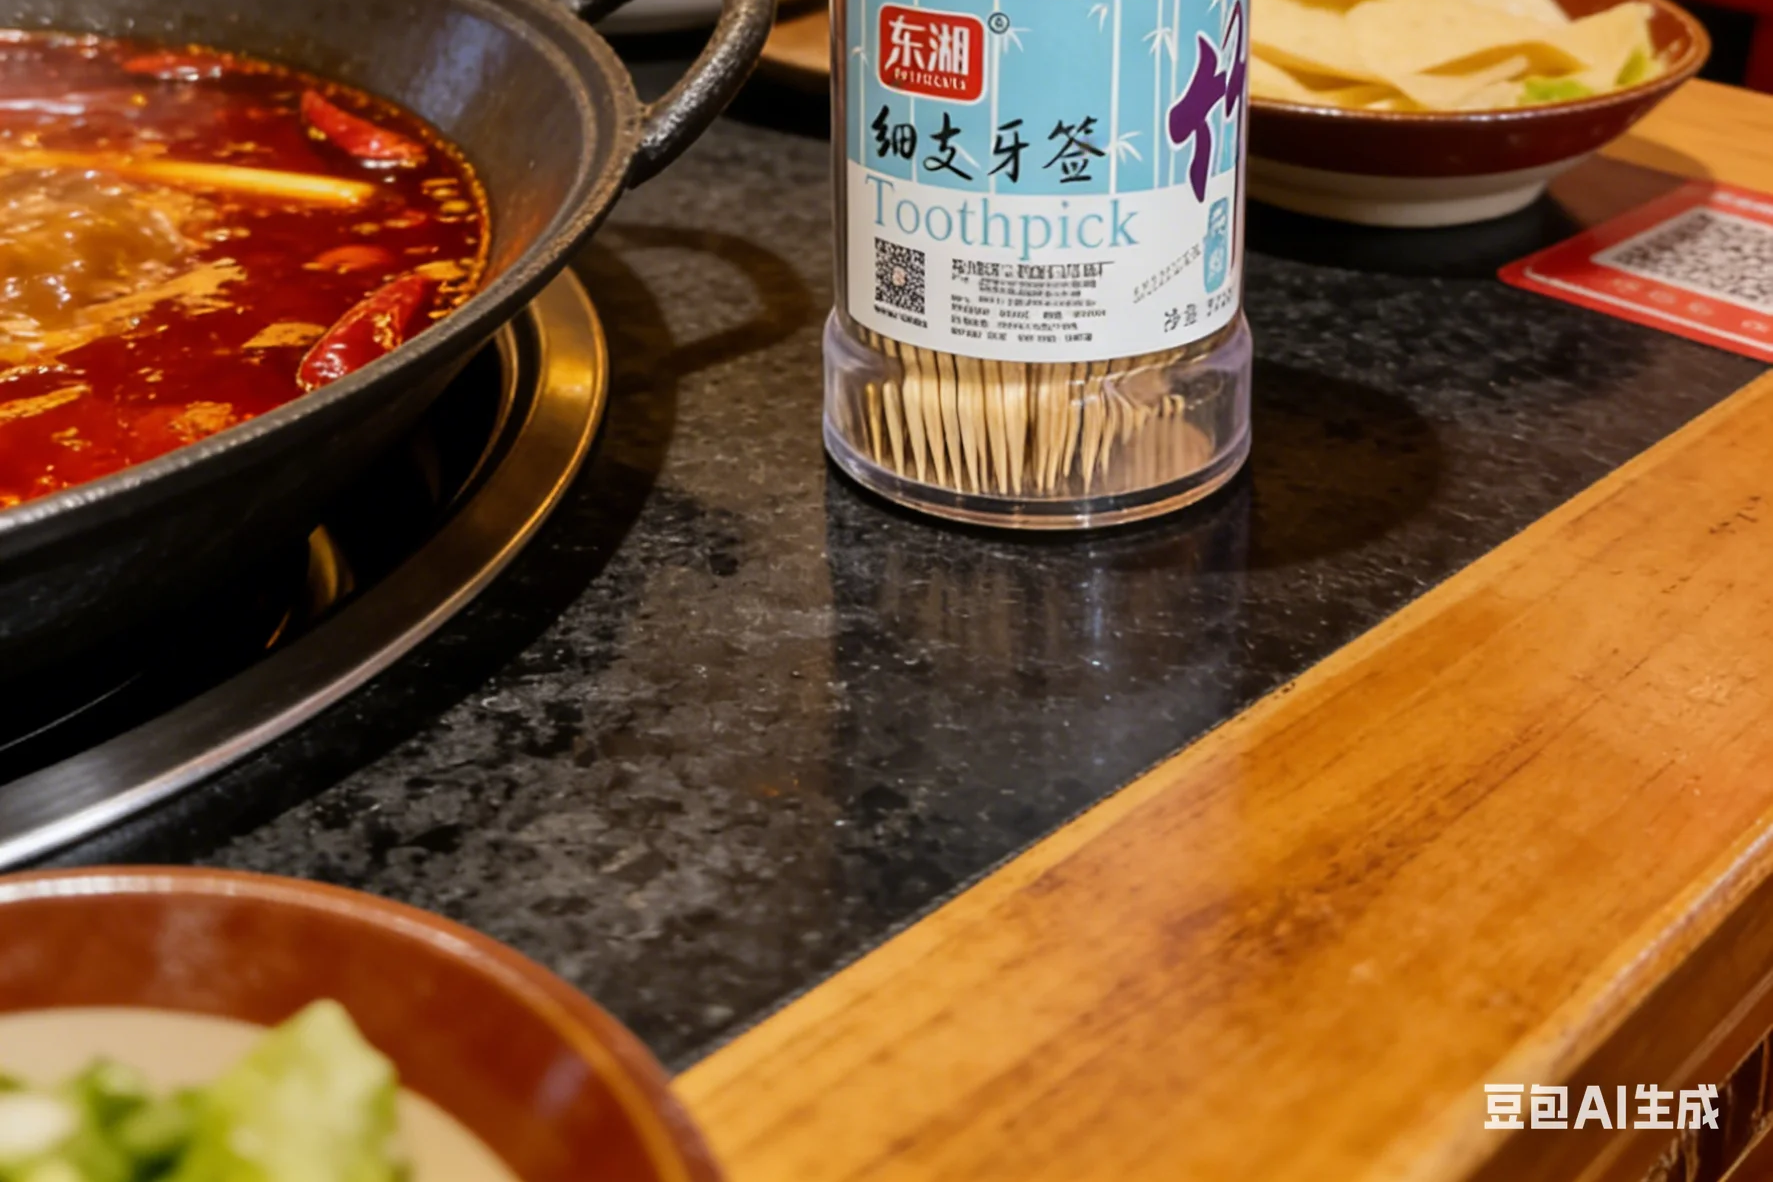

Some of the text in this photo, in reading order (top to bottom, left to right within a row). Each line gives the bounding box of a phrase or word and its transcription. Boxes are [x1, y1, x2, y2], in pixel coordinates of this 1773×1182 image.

[885, 15, 969, 76] 东湘
[871, 105, 1105, 183] 细支牙签
[866, 174, 1139, 261] Toothpick
